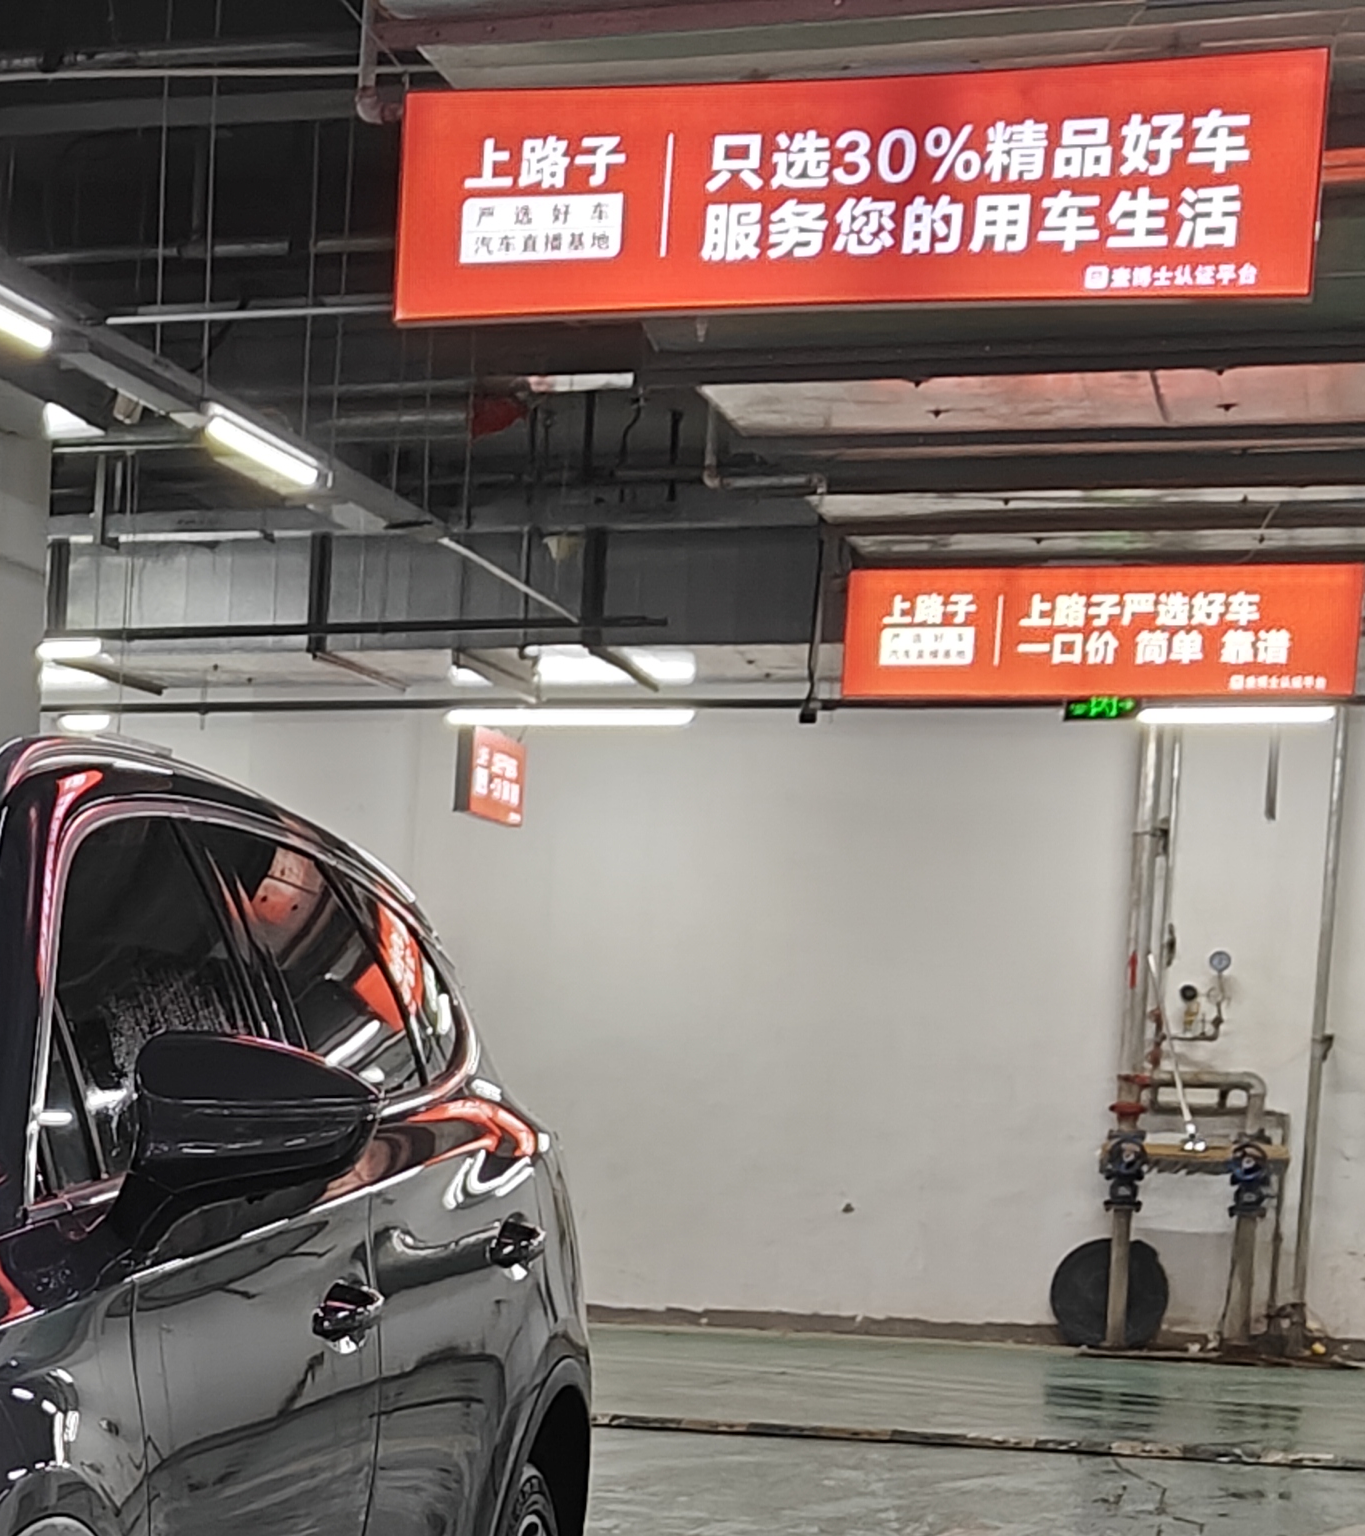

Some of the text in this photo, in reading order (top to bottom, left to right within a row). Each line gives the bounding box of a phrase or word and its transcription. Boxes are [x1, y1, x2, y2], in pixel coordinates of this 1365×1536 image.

[464, 135, 627, 189] 上路子
[705, 109, 1251, 193] 只选30%精品好车
[476, 202, 610, 228] 严选好车
[701, 184, 1242, 261] 服务您的用车生活
[474, 231, 611, 256] 汽车直播基地
[882, 592, 978, 624] 上路子
[1018, 592, 1261, 627] 上路子严选好车
[1017, 628, 1291, 665] 一口价 简单 靠谱
